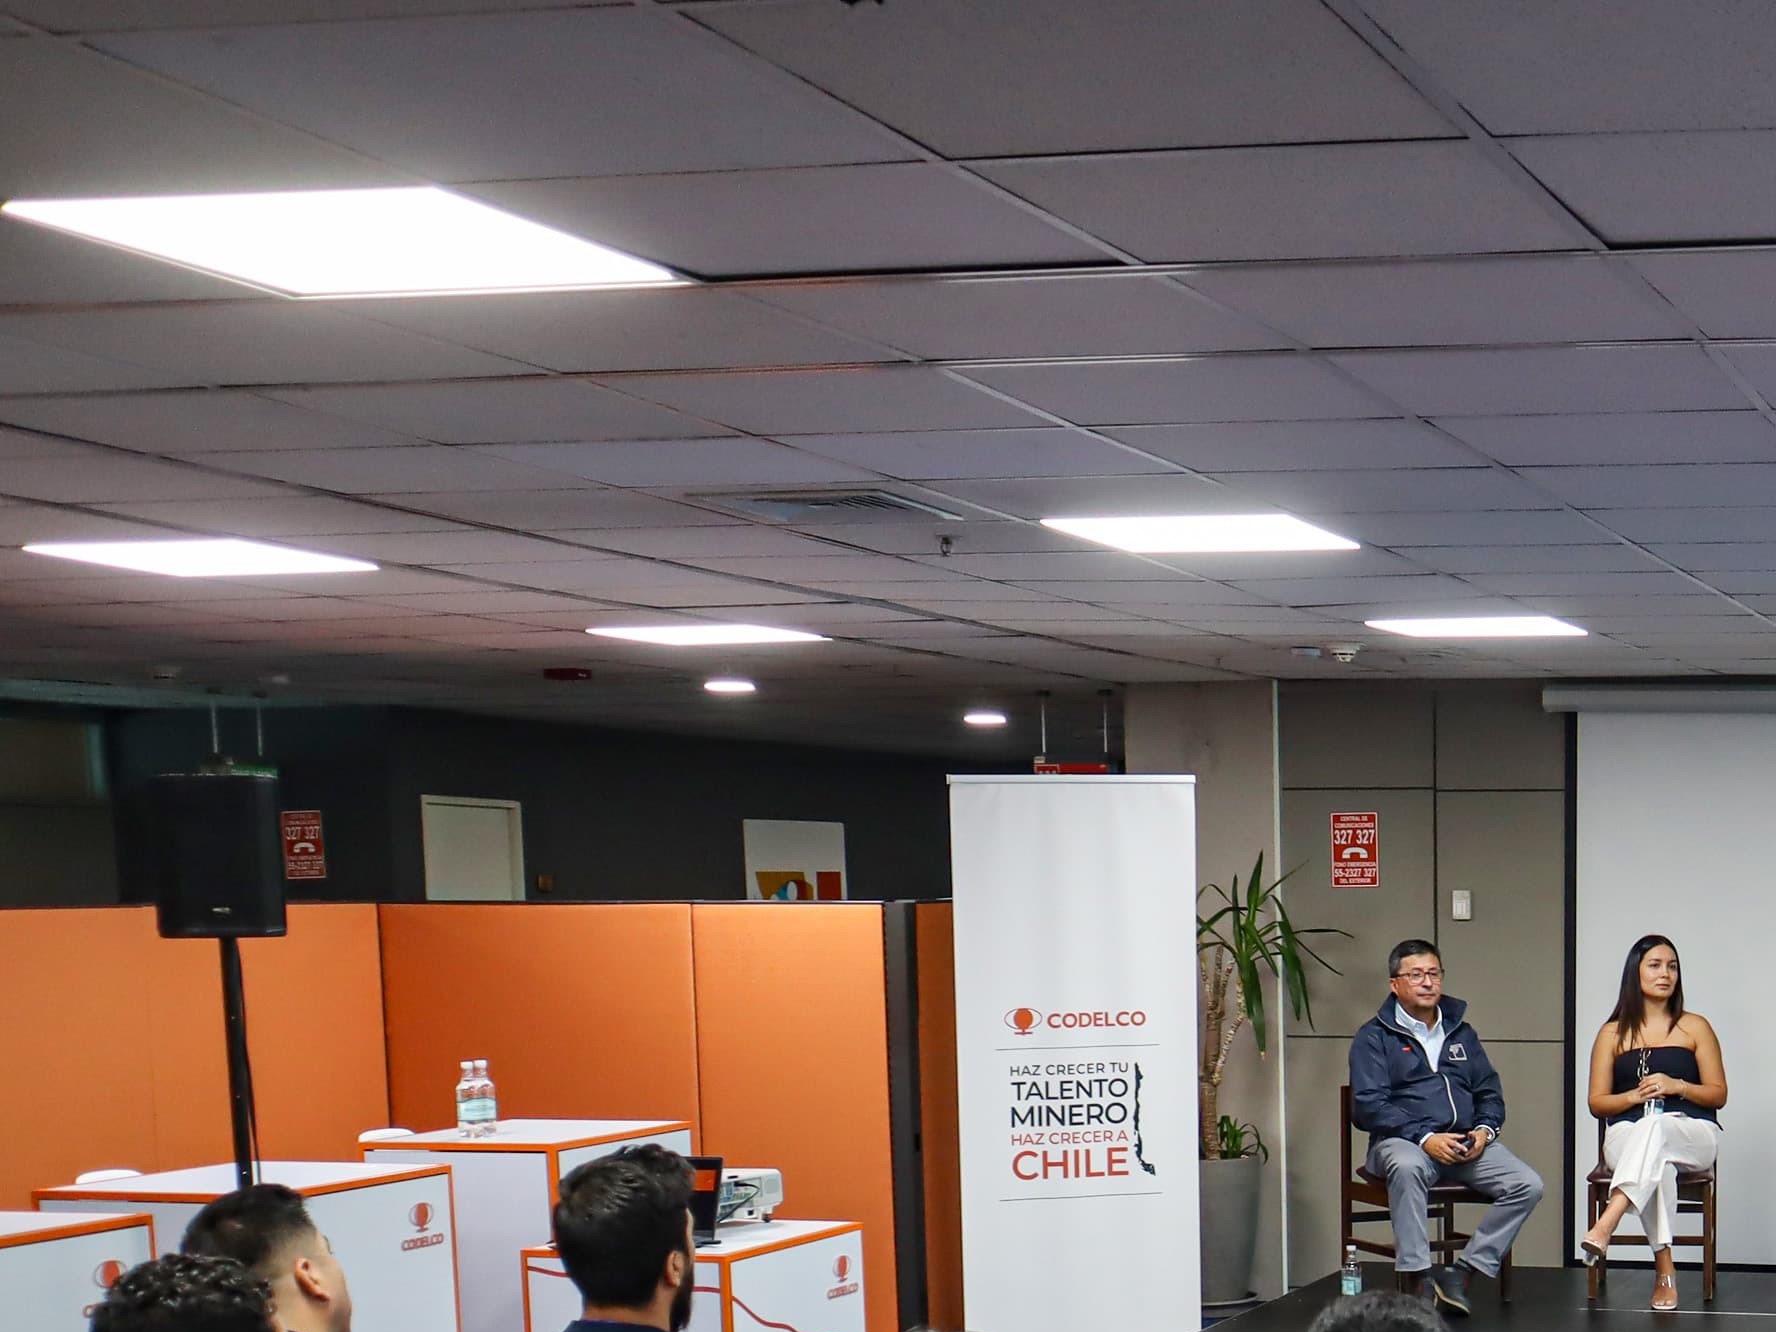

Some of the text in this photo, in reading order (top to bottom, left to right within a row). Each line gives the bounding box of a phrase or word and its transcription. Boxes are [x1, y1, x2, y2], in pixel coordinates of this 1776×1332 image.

[1334, 829, 1375, 845] 327 327
[1046, 1011, 1147, 1029] CODELCO
[1010, 1062, 1129, 1076] HAZ CRECER TU
[1010, 1078, 1129, 1101] TALENTO
[1010, 1102, 1128, 1128] MINERO
[1010, 1130, 1129, 1146] HAZ CRECER A
[1012, 1146, 1130, 1180] CHILE
